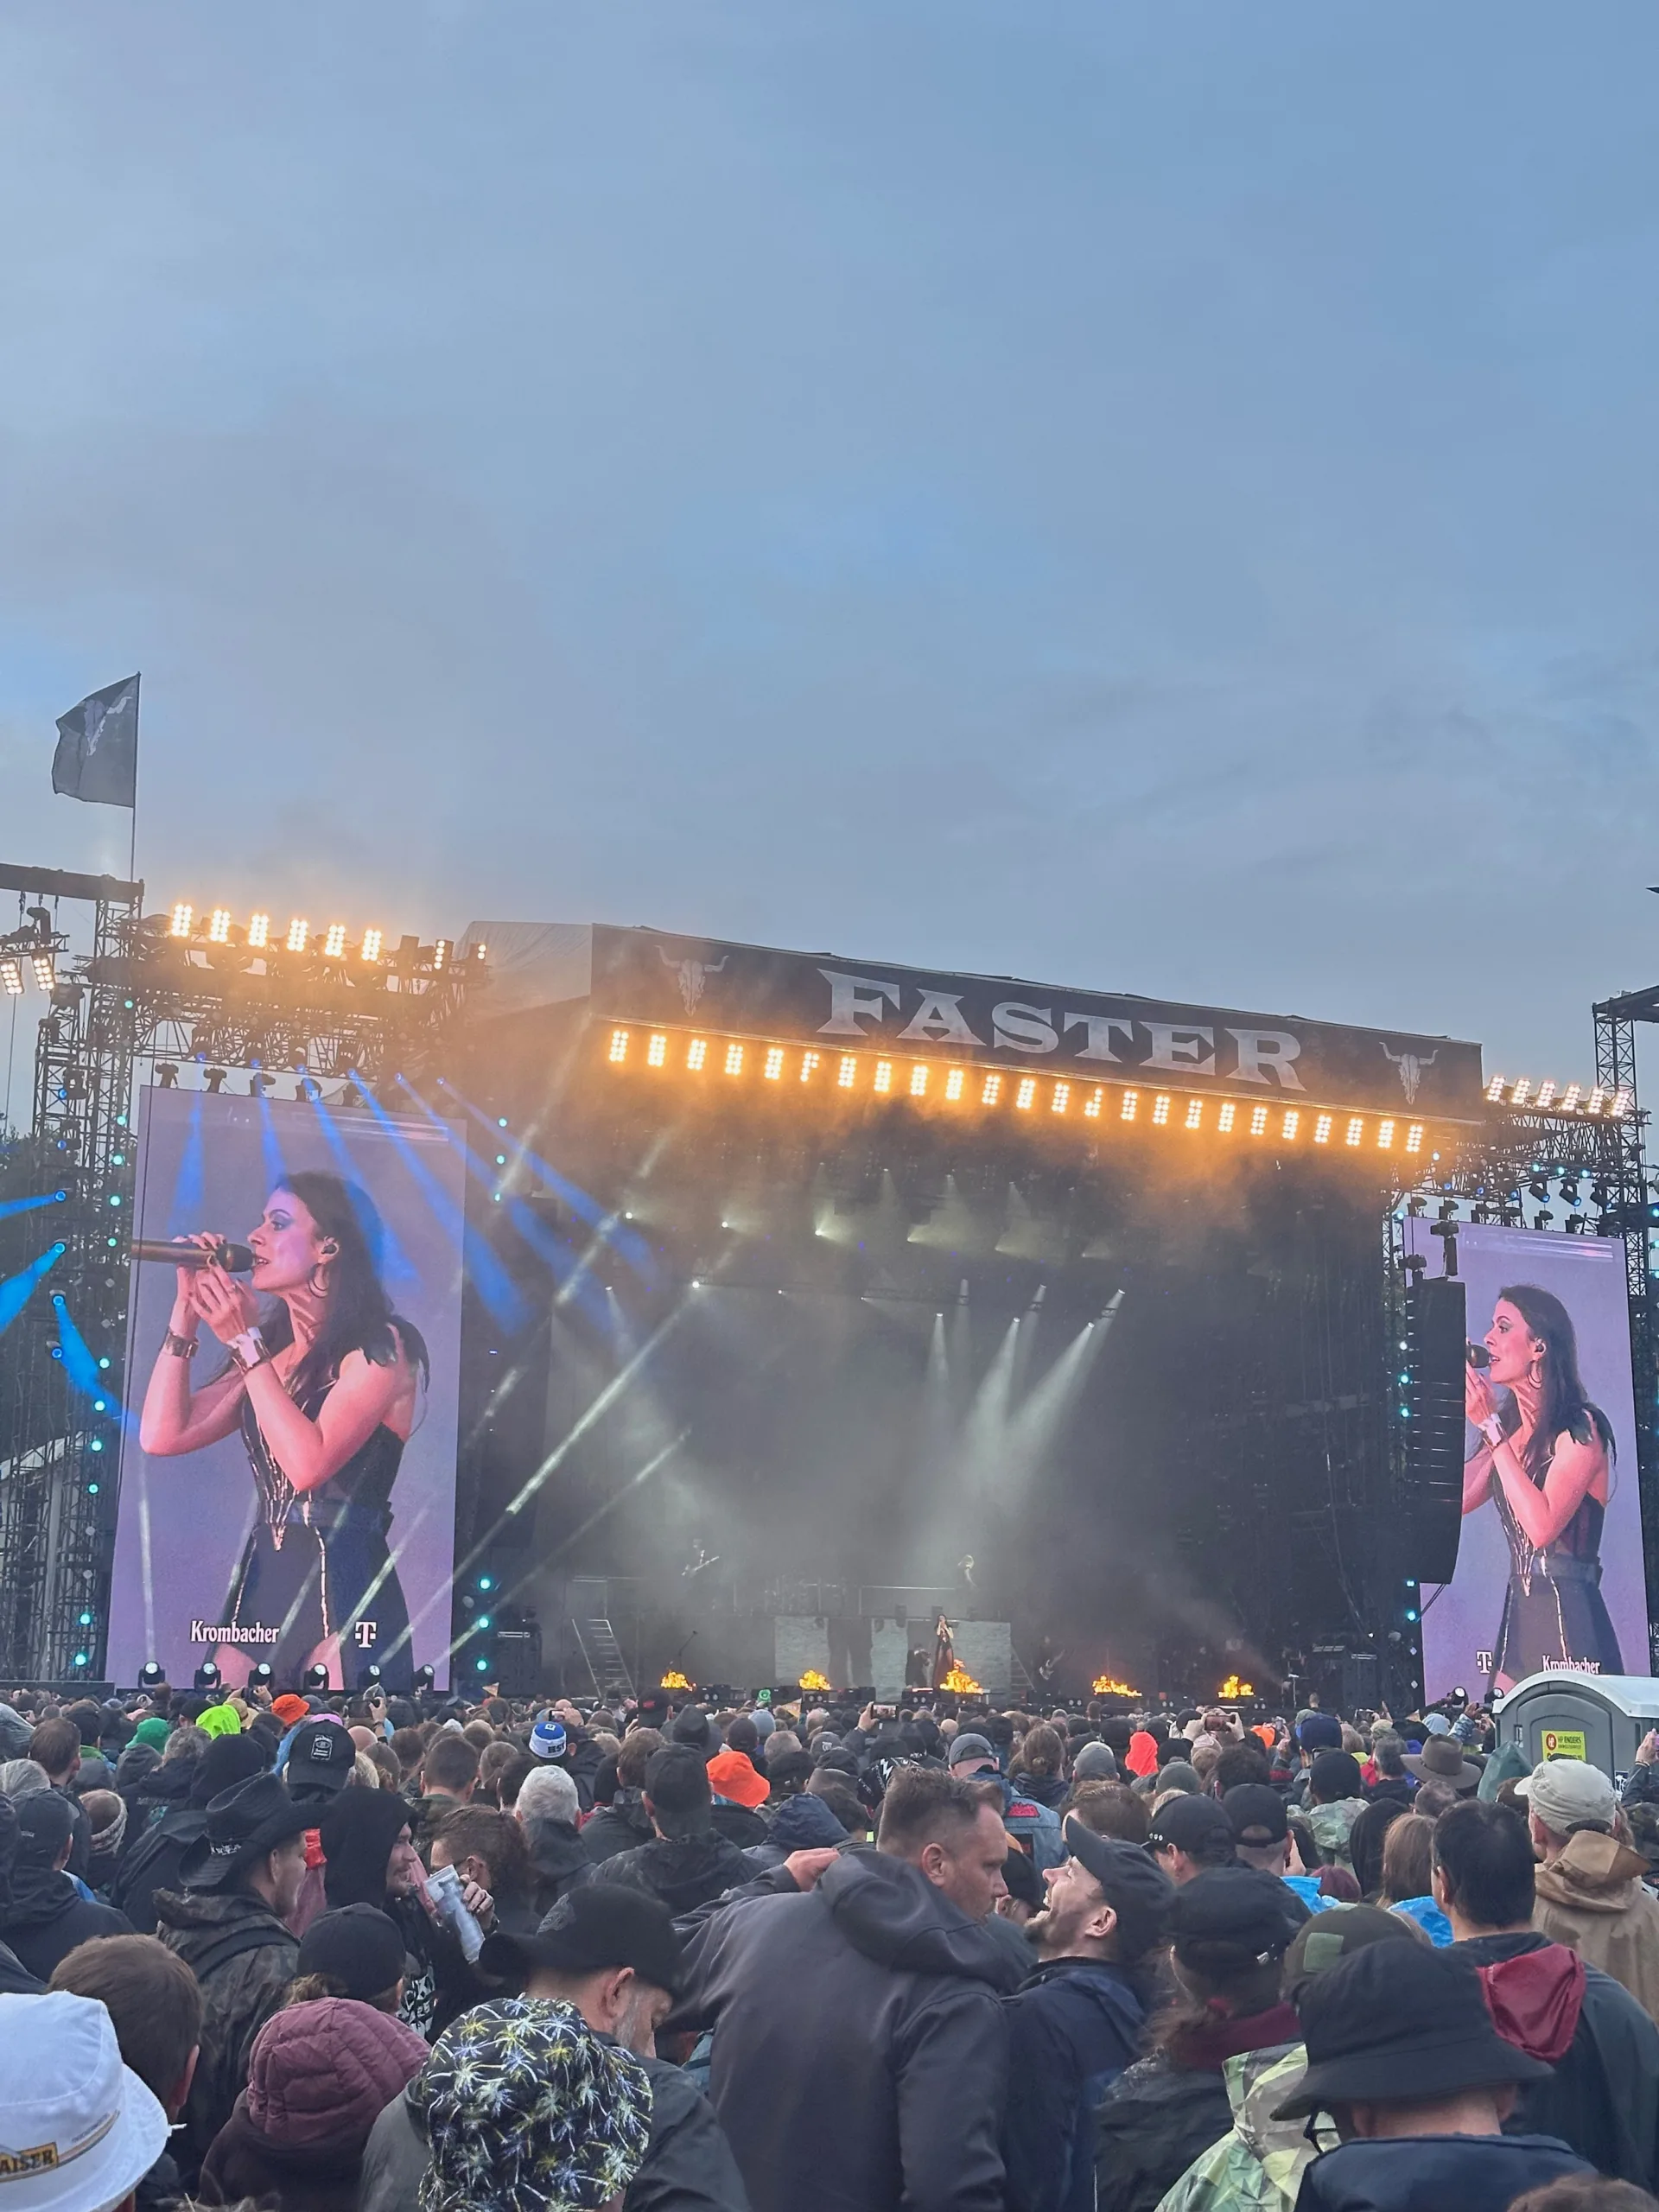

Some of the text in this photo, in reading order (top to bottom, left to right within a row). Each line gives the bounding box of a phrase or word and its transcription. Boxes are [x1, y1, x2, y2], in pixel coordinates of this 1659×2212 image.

[817, 968, 1307, 1092] FASTER
[190, 1620, 280, 1643] Krombacher
[355, 1621, 377, 1648] T
[1476, 1651, 1492, 1674] T
